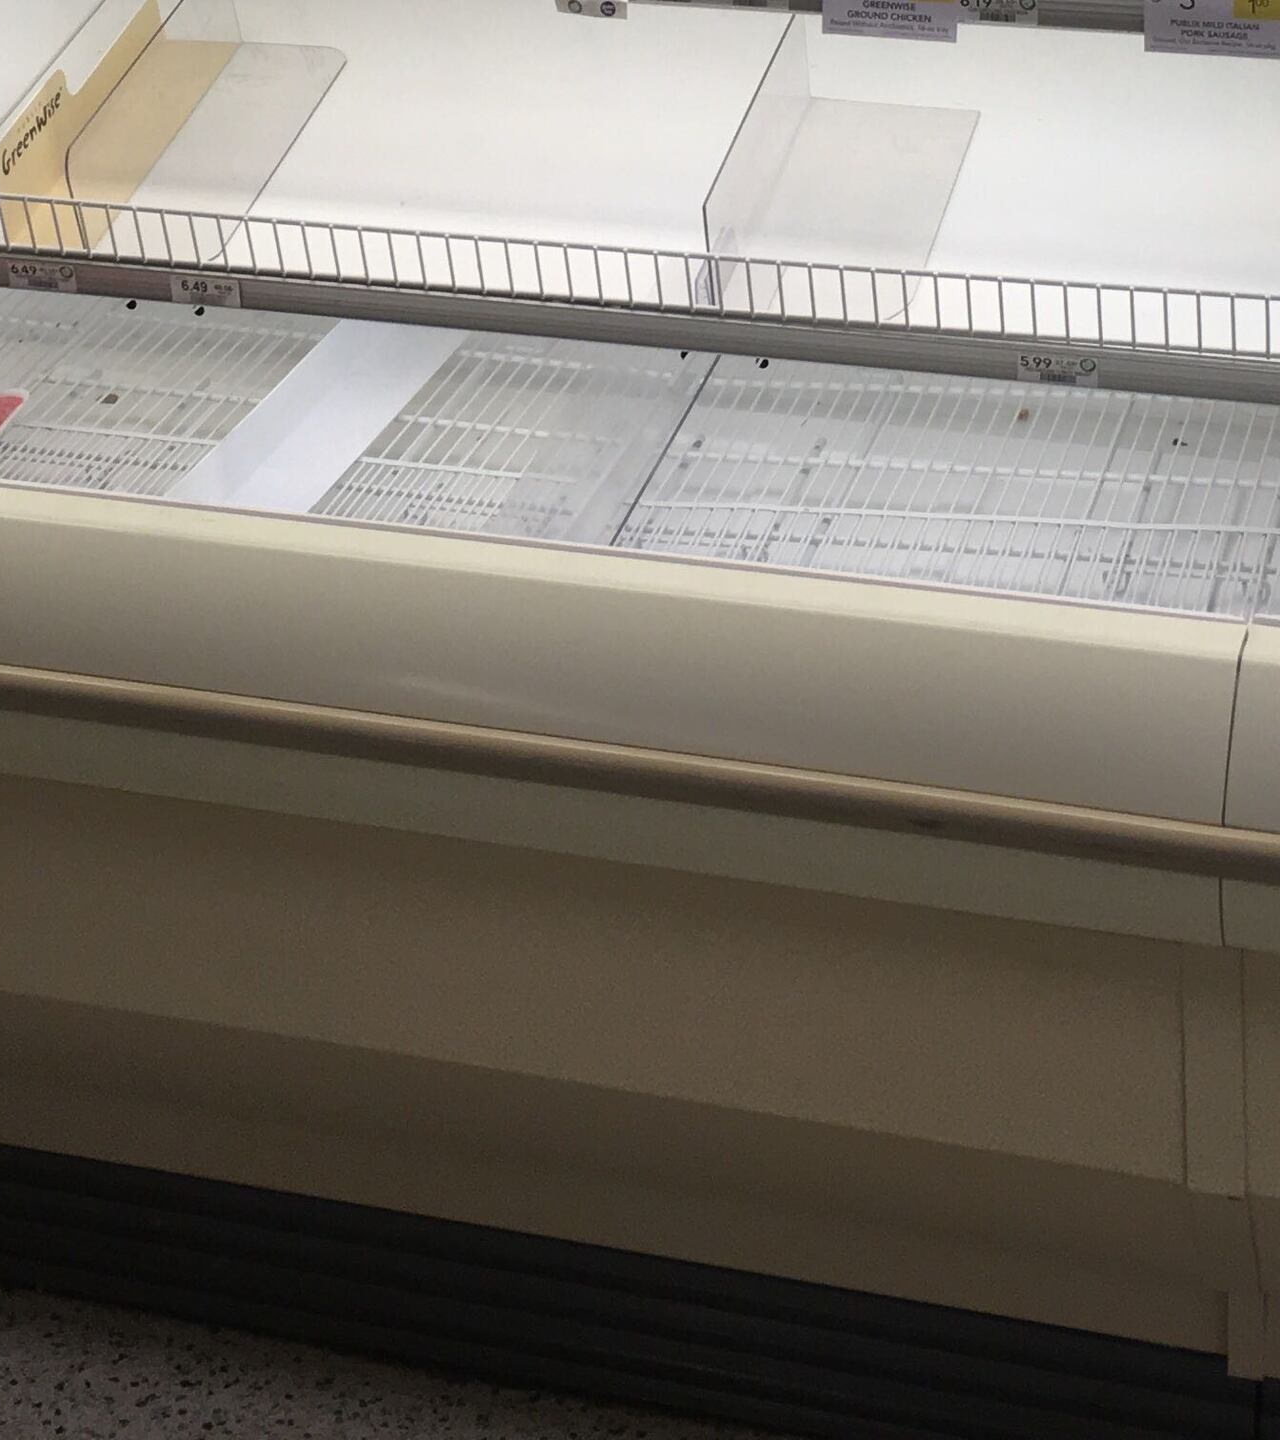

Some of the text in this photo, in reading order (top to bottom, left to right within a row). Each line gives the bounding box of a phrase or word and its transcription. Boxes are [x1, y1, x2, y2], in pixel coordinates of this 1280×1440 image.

[862, 0, 917, 11] GREENWISE
[847, 9, 932, 23] GROUND CHICKEN
[1, 91, 63, 176] GreenWise
